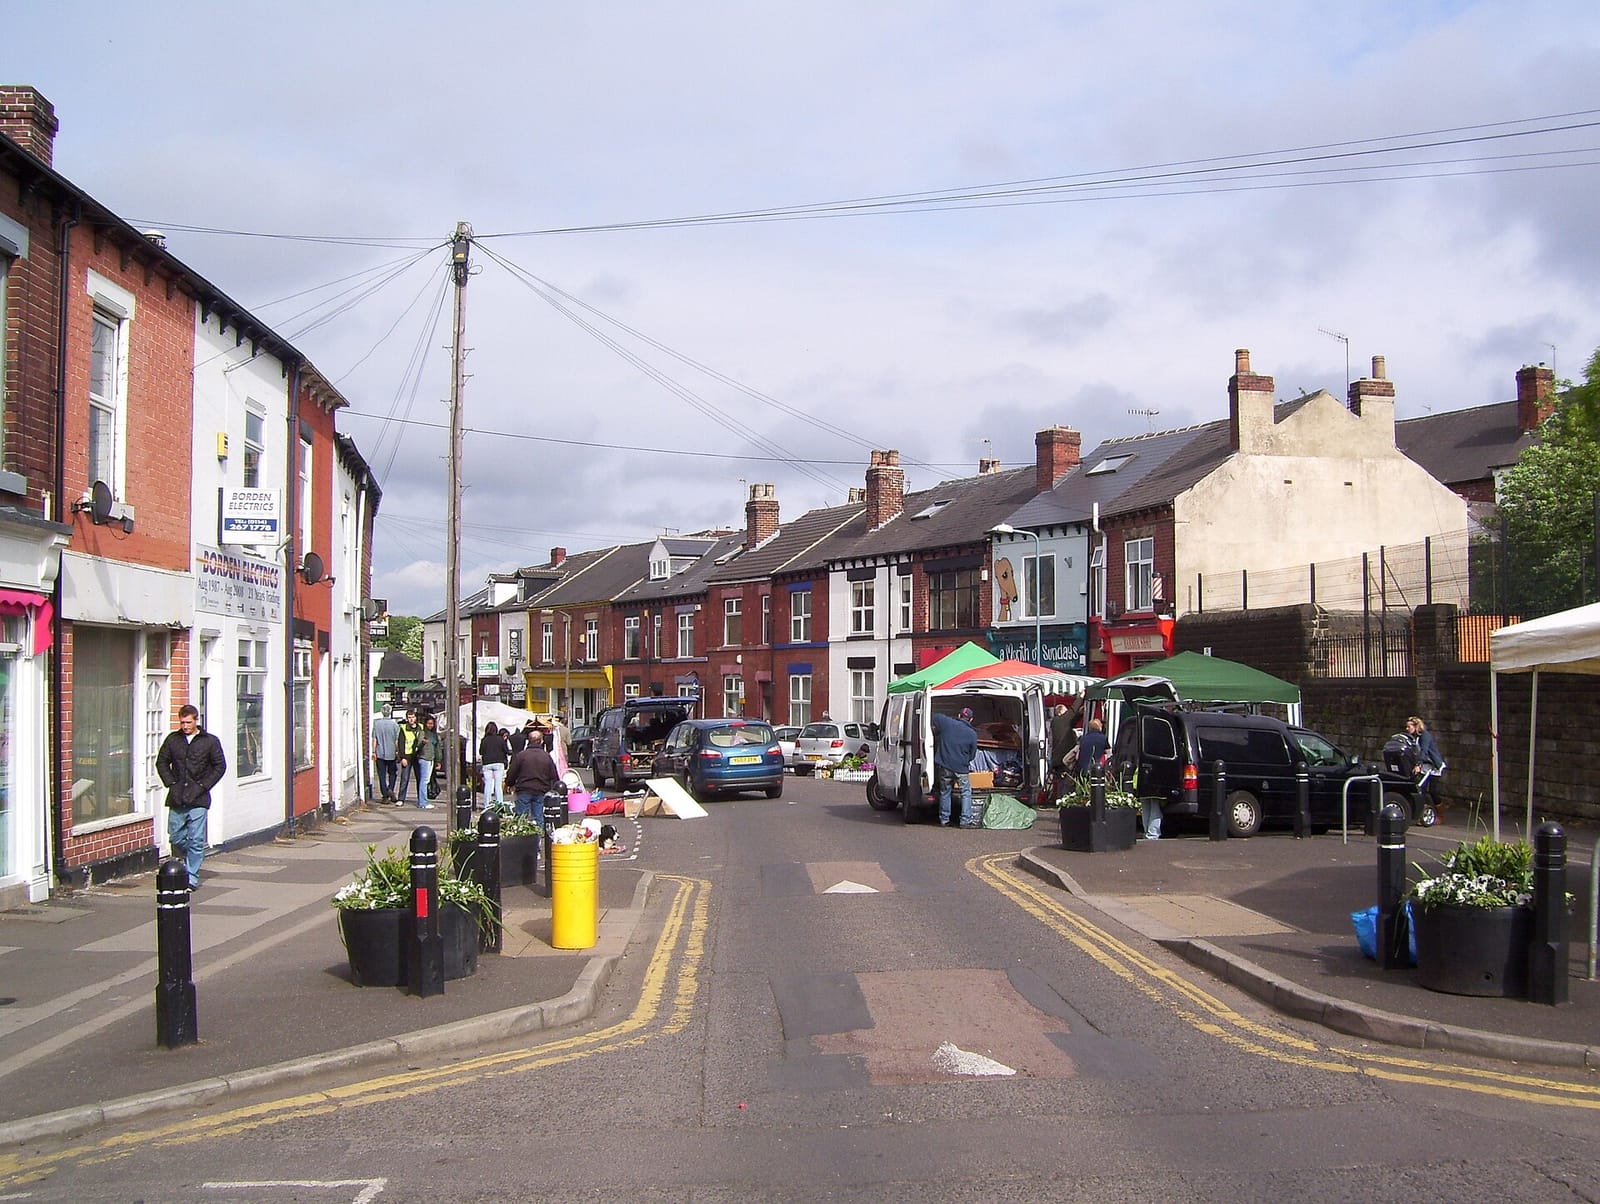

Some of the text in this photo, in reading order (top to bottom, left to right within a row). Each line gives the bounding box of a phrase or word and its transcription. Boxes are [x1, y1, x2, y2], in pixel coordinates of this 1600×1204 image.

[232, 492, 272, 501] BORDEN
[228, 502, 274, 510] ELECTRICS
[202, 550, 278, 589] BORDEN ELECTRICS
[1006, 642, 1030, 662] Month
[1042, 641, 1079, 660] Sundays
